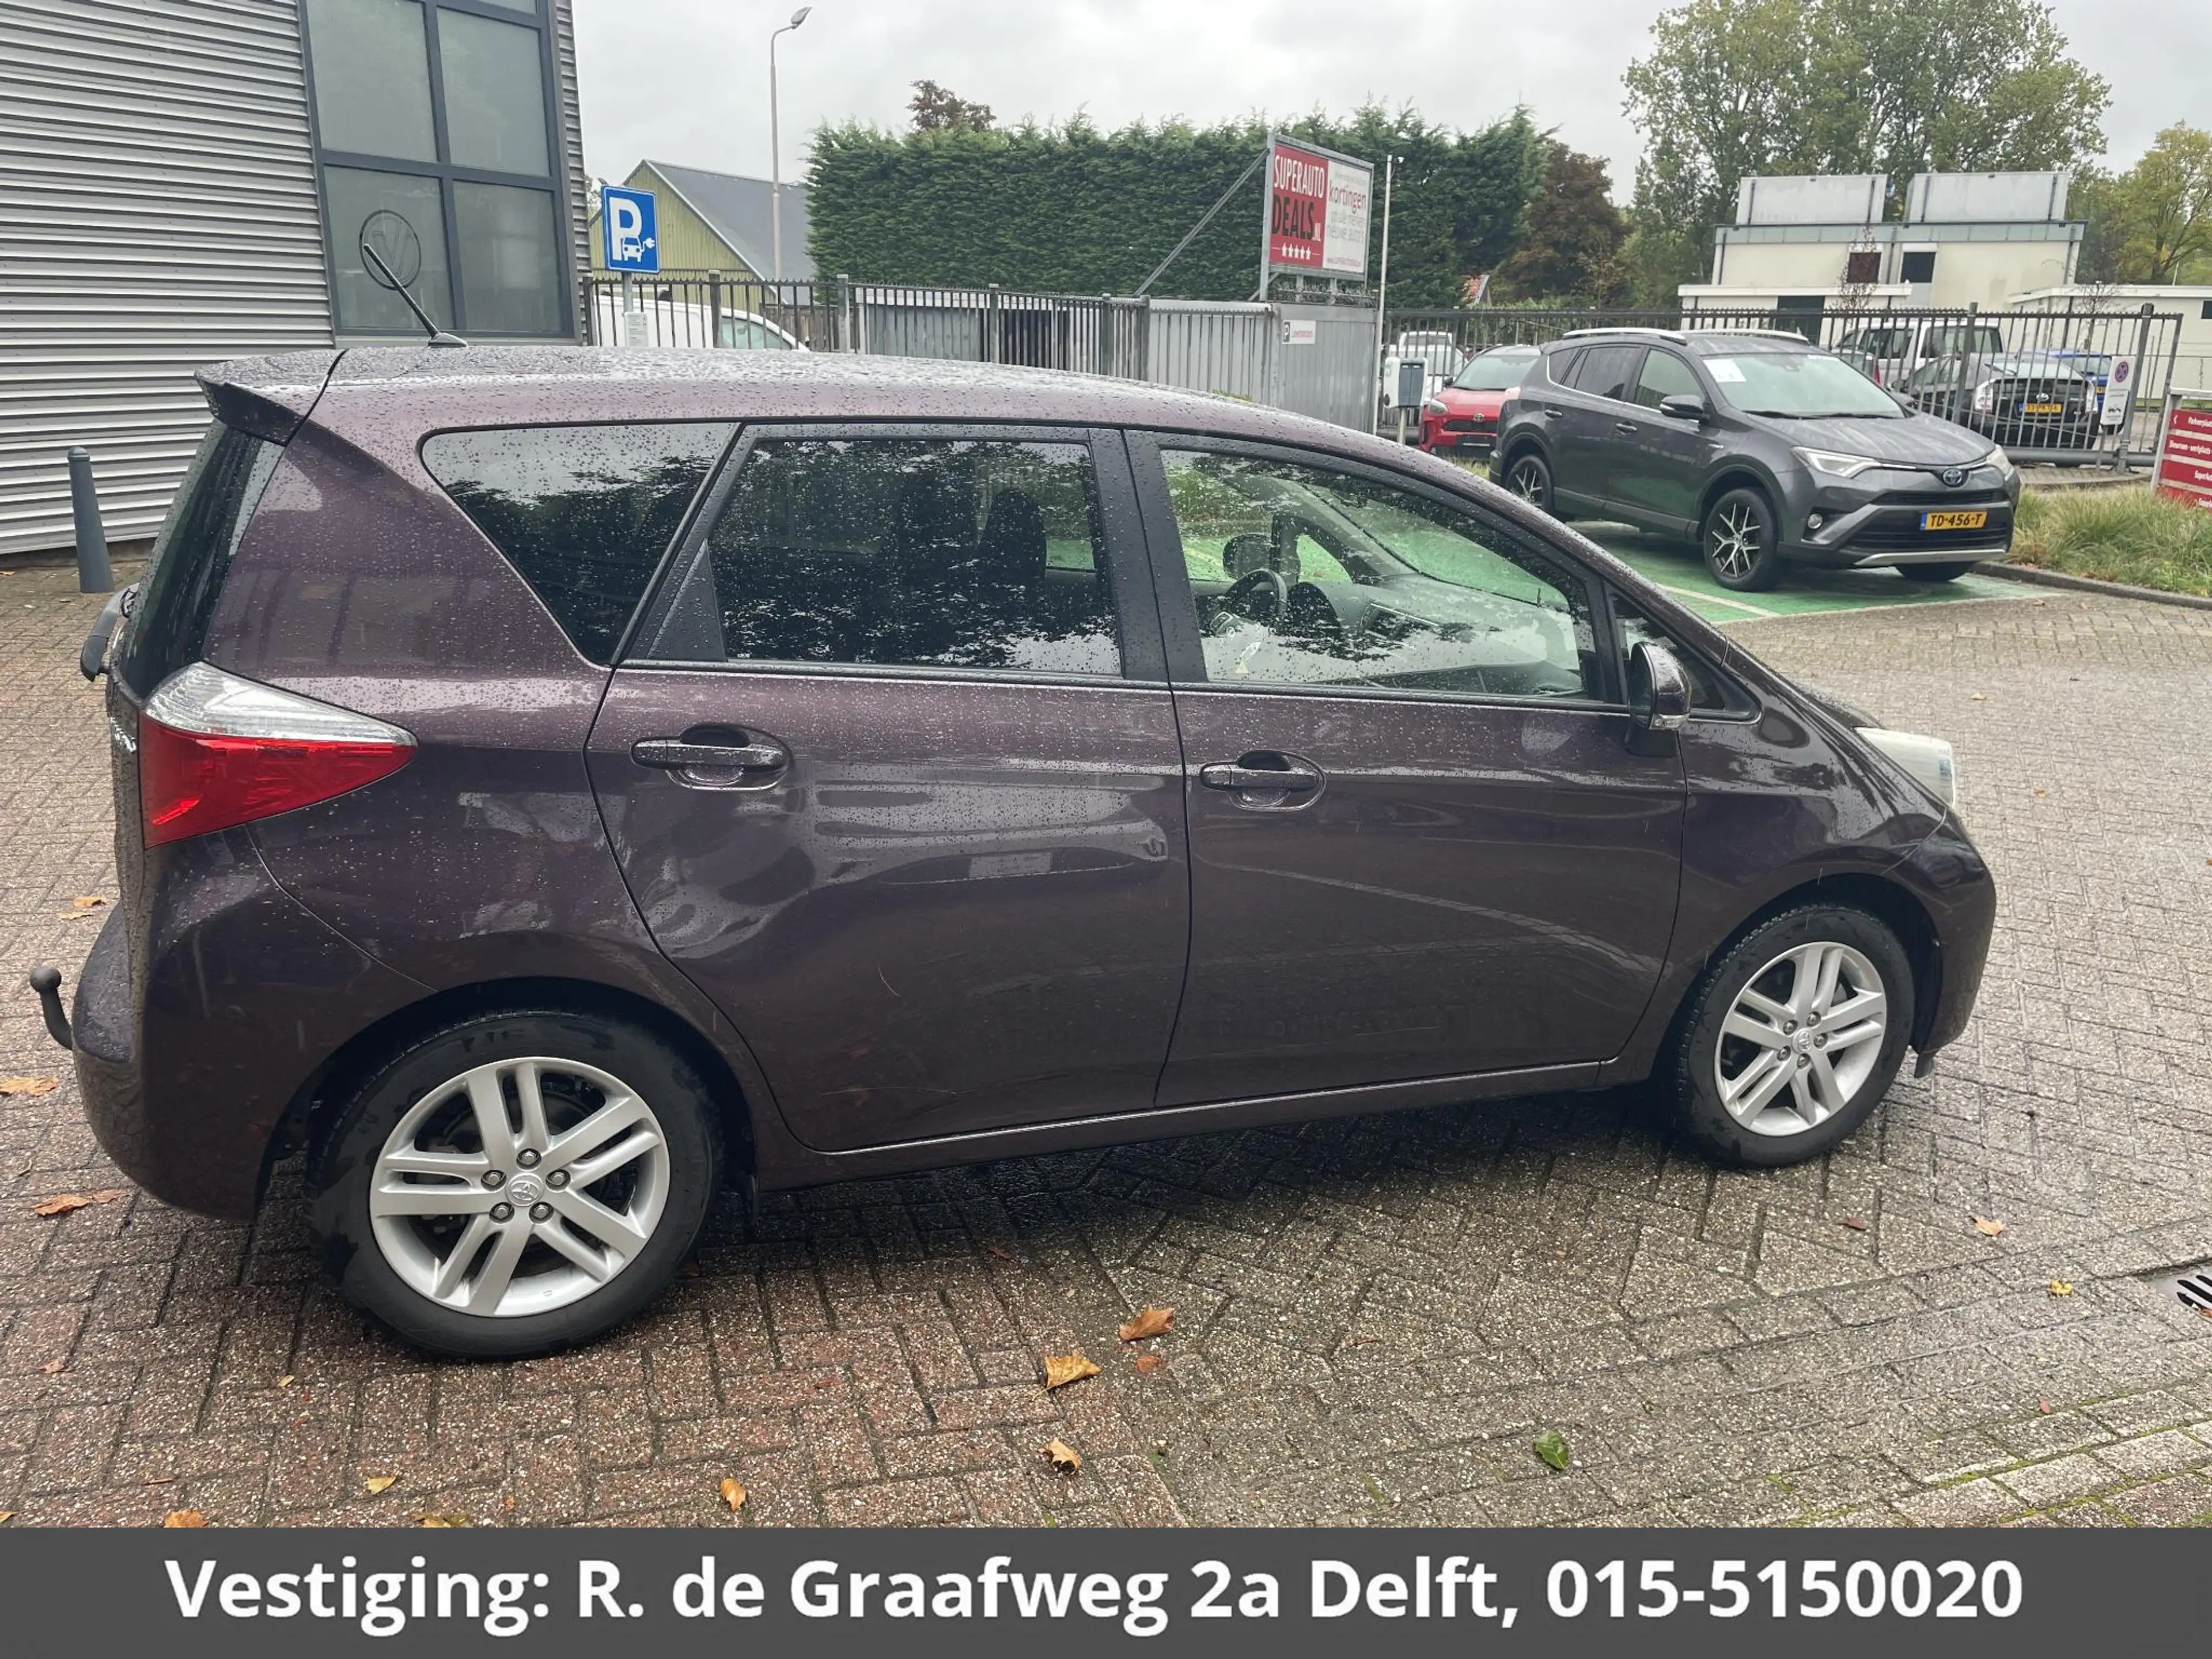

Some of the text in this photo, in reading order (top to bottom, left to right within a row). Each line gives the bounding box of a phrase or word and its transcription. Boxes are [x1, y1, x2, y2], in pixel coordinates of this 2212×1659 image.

[1274, 155, 1325, 199] SUPERAUTO
[1328, 179, 1366, 214] kortingen
[609, 196, 642, 260] P
[1930, 513, 1983, 527] TD-456-T
